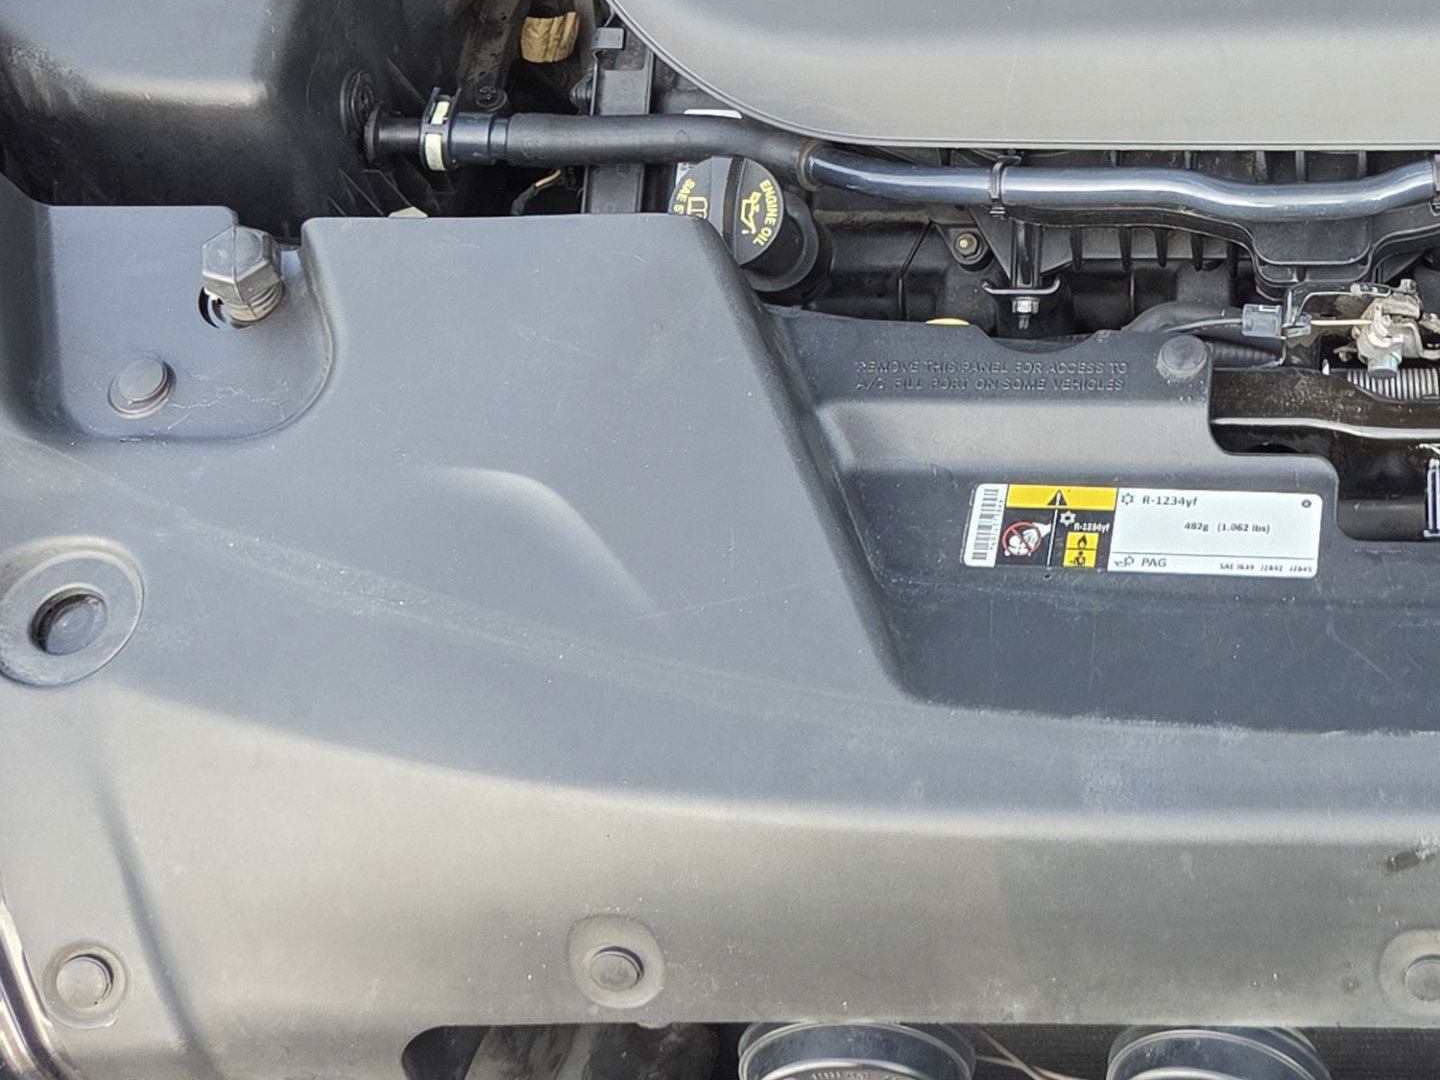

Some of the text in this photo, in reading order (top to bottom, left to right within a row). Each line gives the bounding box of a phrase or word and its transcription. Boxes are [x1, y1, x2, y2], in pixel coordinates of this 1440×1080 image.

[676, 178, 696, 202] SAE
[753, 179, 779, 247] ENGINE OIL
[855, 360, 1128, 374] REMOVE THIS PANEL FOR ACCESS TO
[894, 377, 923, 391] FILL
[930, 377, 969, 391] PORT
[974, 377, 999, 391] ON
[1003, 377, 1046, 391] SOME
[1052, 377, 1125, 391] VEHICLES
[1142, 494, 1198, 508] R-1234yf
[1184, 522, 1271, 534] 482g (1.062 lbs)
[1141, 558, 1167, 568] PAG
